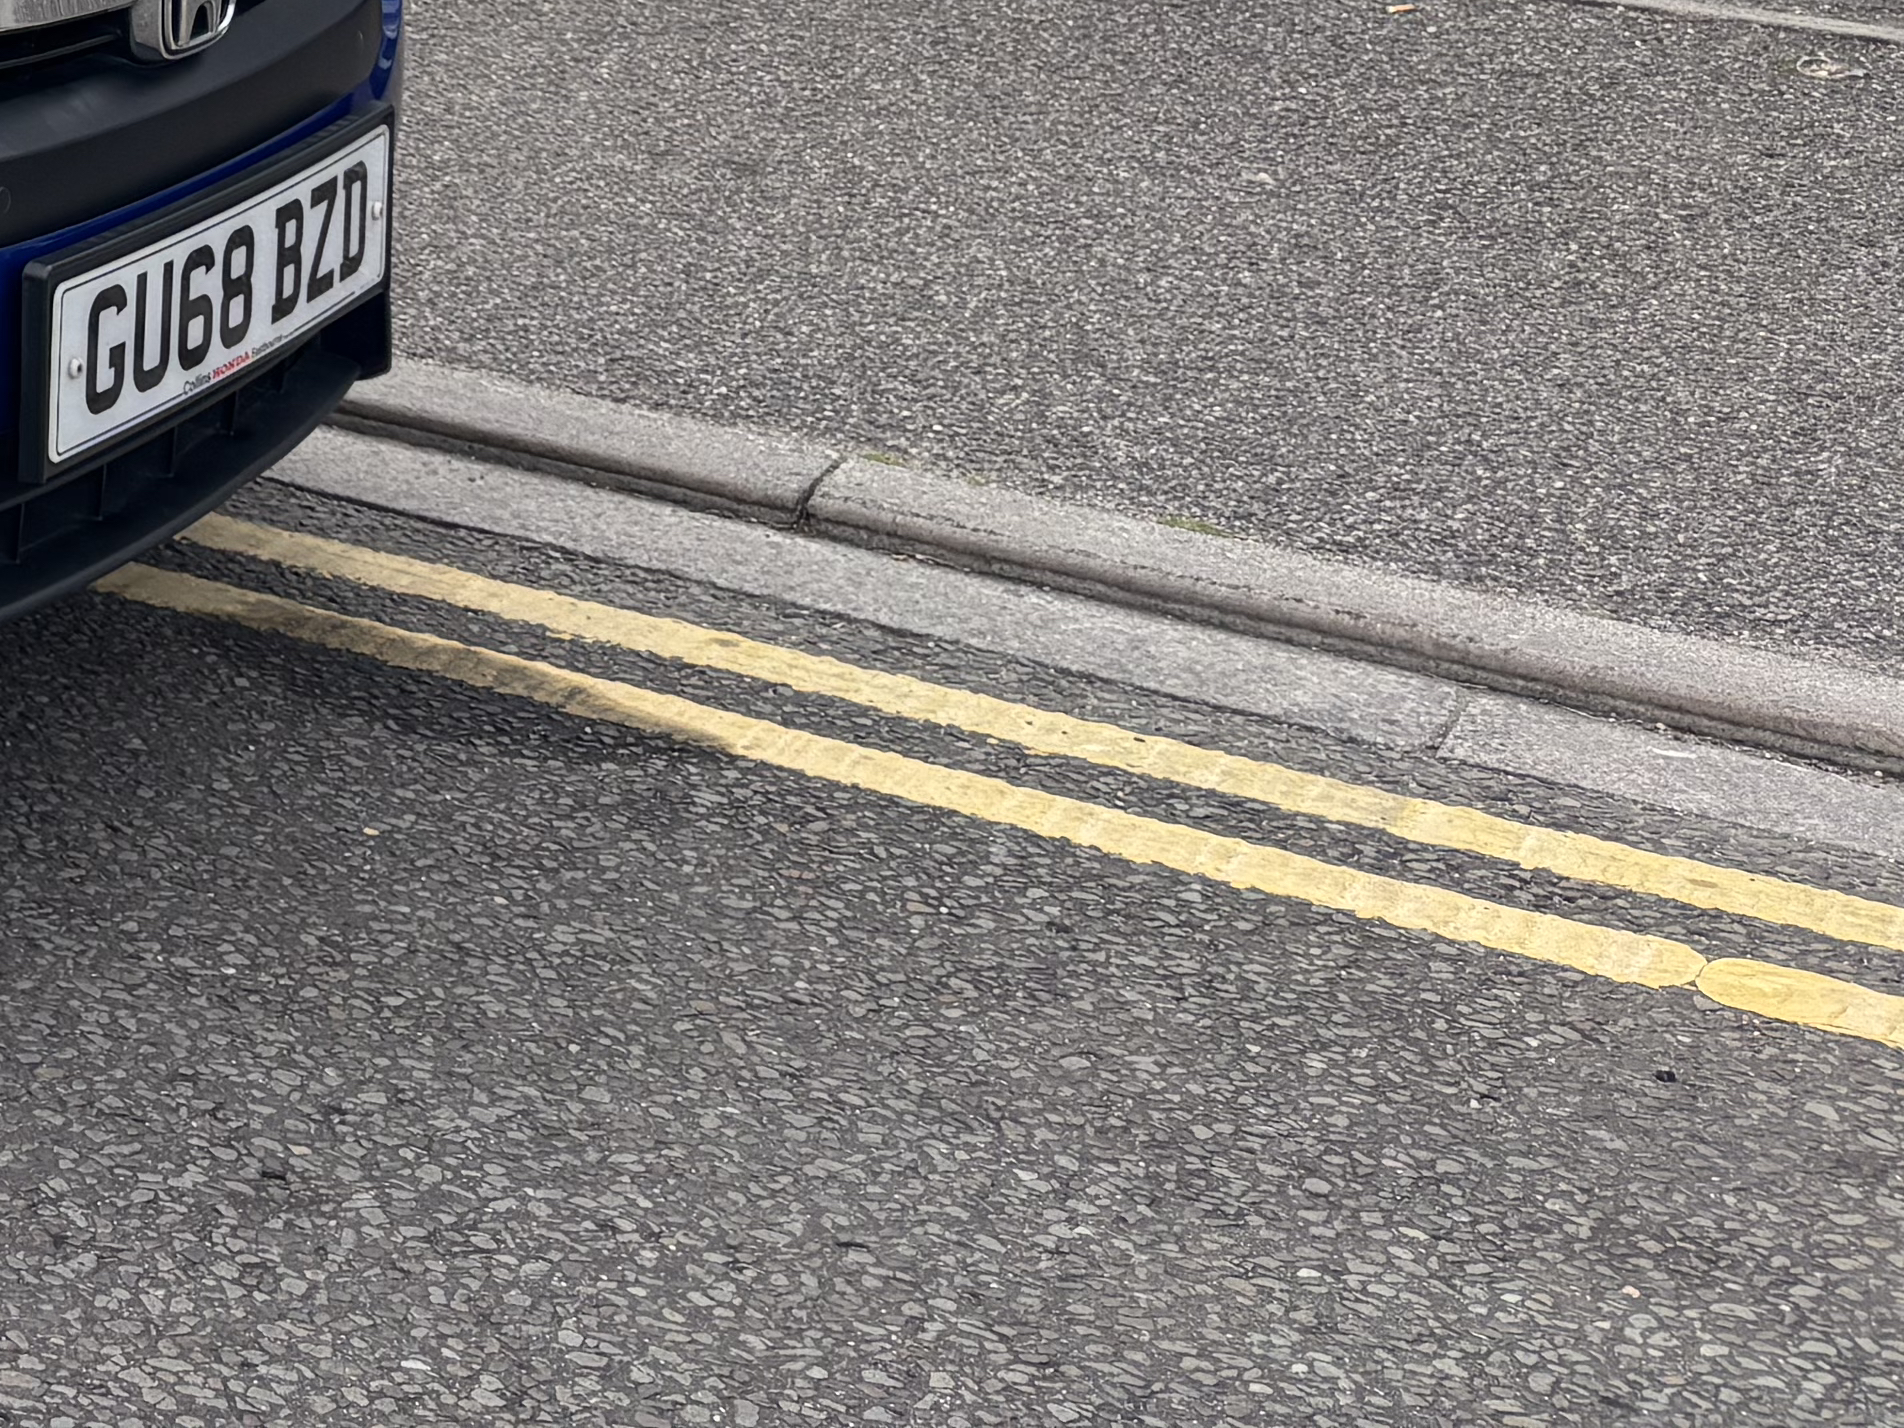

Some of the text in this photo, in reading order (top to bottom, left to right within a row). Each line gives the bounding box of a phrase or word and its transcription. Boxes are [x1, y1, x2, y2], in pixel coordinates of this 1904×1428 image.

[85, 159, 368, 416] GU68 BZD
[212, 351, 250, 380] HONDA
